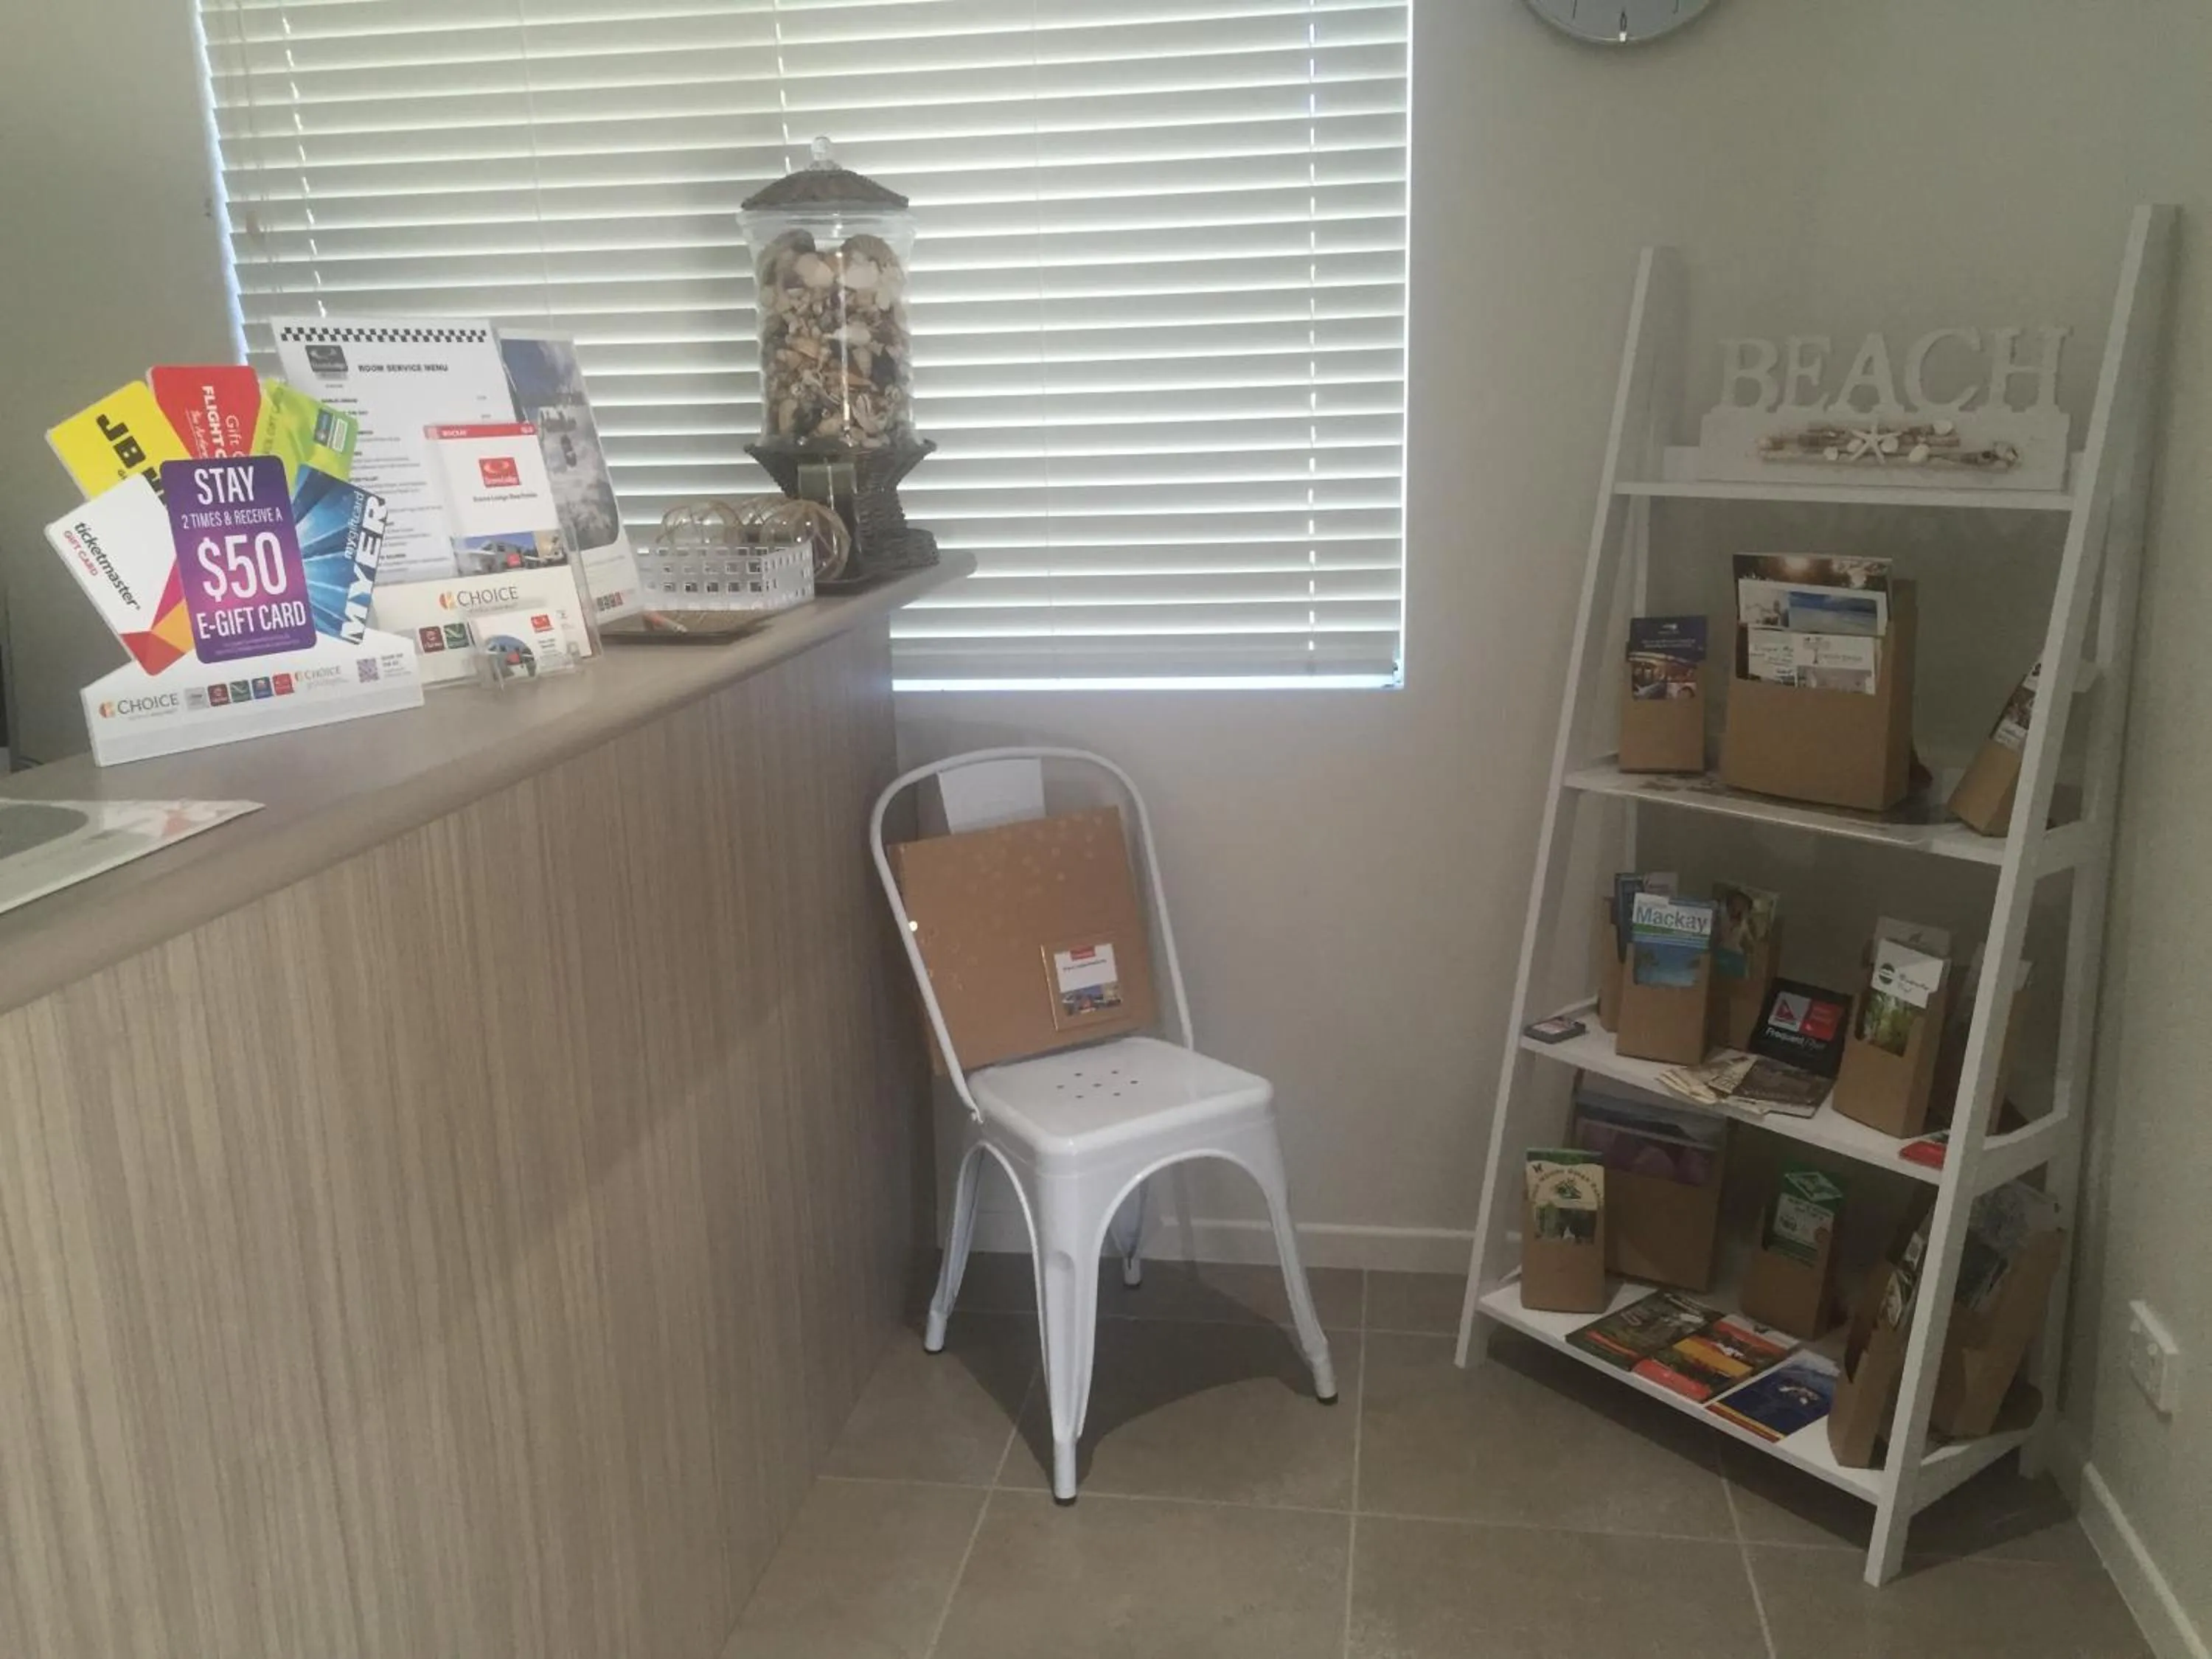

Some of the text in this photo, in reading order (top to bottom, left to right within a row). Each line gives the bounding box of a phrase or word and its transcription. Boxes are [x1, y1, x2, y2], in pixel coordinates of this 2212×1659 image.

[357, 364, 449, 372] ROOM SERVICE MENU
[1719, 325, 2073, 414] BEACH
[201, 385, 225, 447] FLIGHT
[225, 414, 243, 446] Gift
[95, 413, 147, 470] JB
[193, 465, 255, 506] STAY
[181, 506, 284, 529] 2 TIMES & RECEIVE A
[344, 490, 365, 560] mygiftcard
[63, 529, 99, 577] GIFT CARD
[74, 522, 139, 606] ticketmaster
[196, 531, 288, 602] $50
[339, 495, 389, 644] MYER
[456, 586, 520, 608] CHOICE
[196, 601, 307, 640] E-GIFT CARD
[304, 665, 342, 681] CHOICE
[117, 693, 181, 714] CHOICE
[1635, 905, 1710, 933] Mackay
